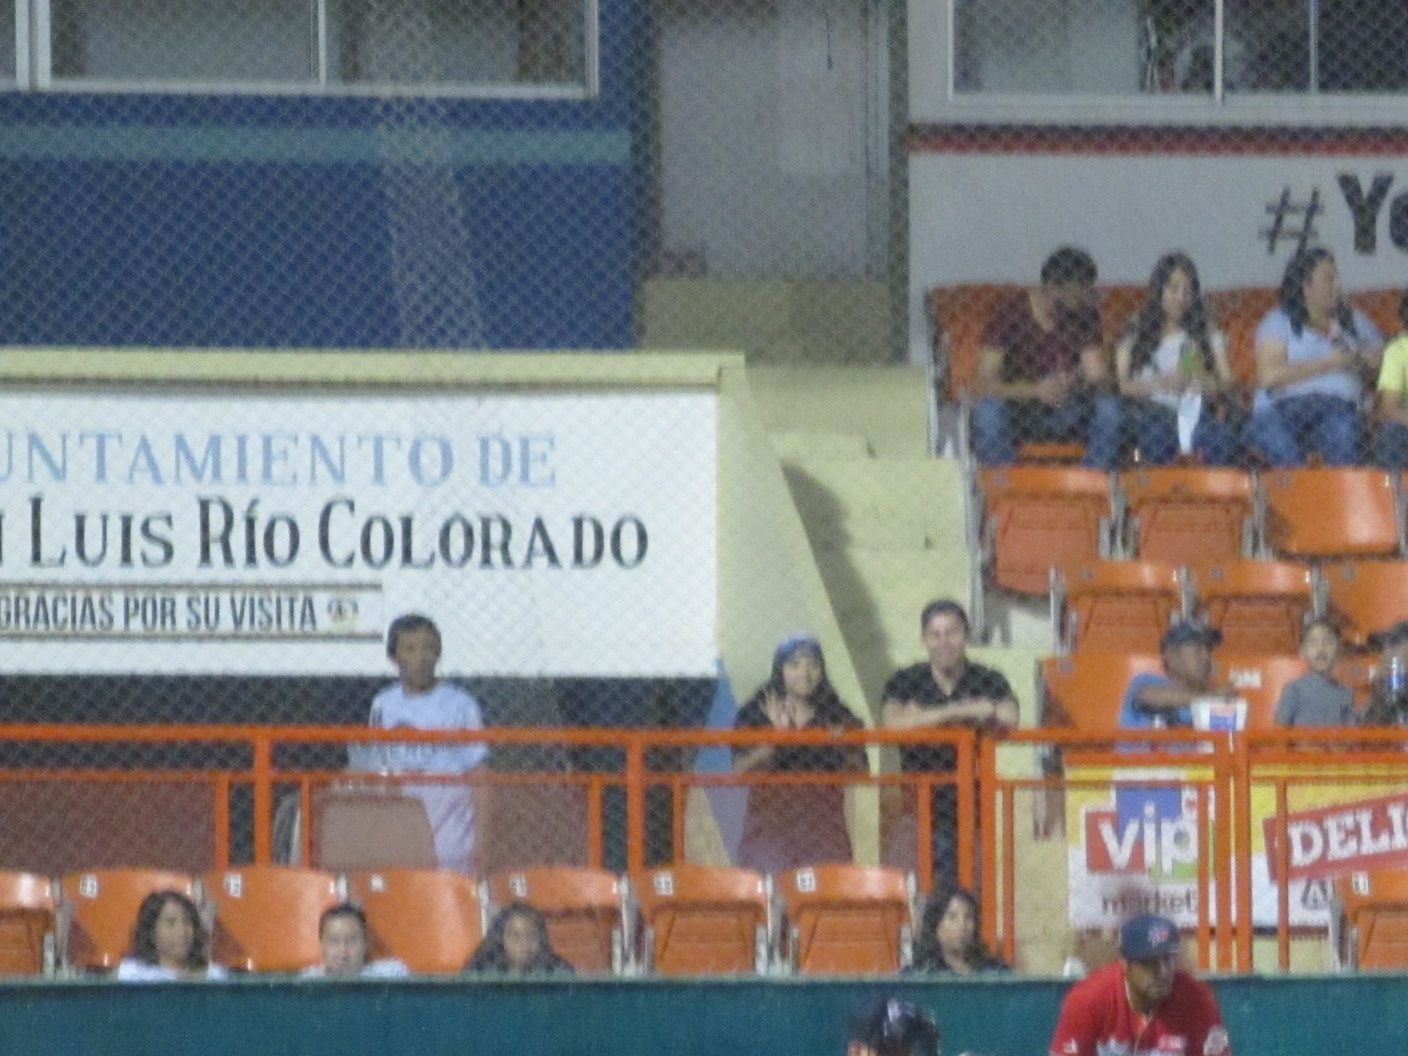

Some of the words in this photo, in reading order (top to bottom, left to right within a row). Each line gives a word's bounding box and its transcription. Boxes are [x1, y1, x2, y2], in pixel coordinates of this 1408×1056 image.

[476, 432, 557, 487] DE
[124, 594, 177, 631] POR
[186, 594, 221, 632] SU
[229, 594, 317, 632] VISITA
